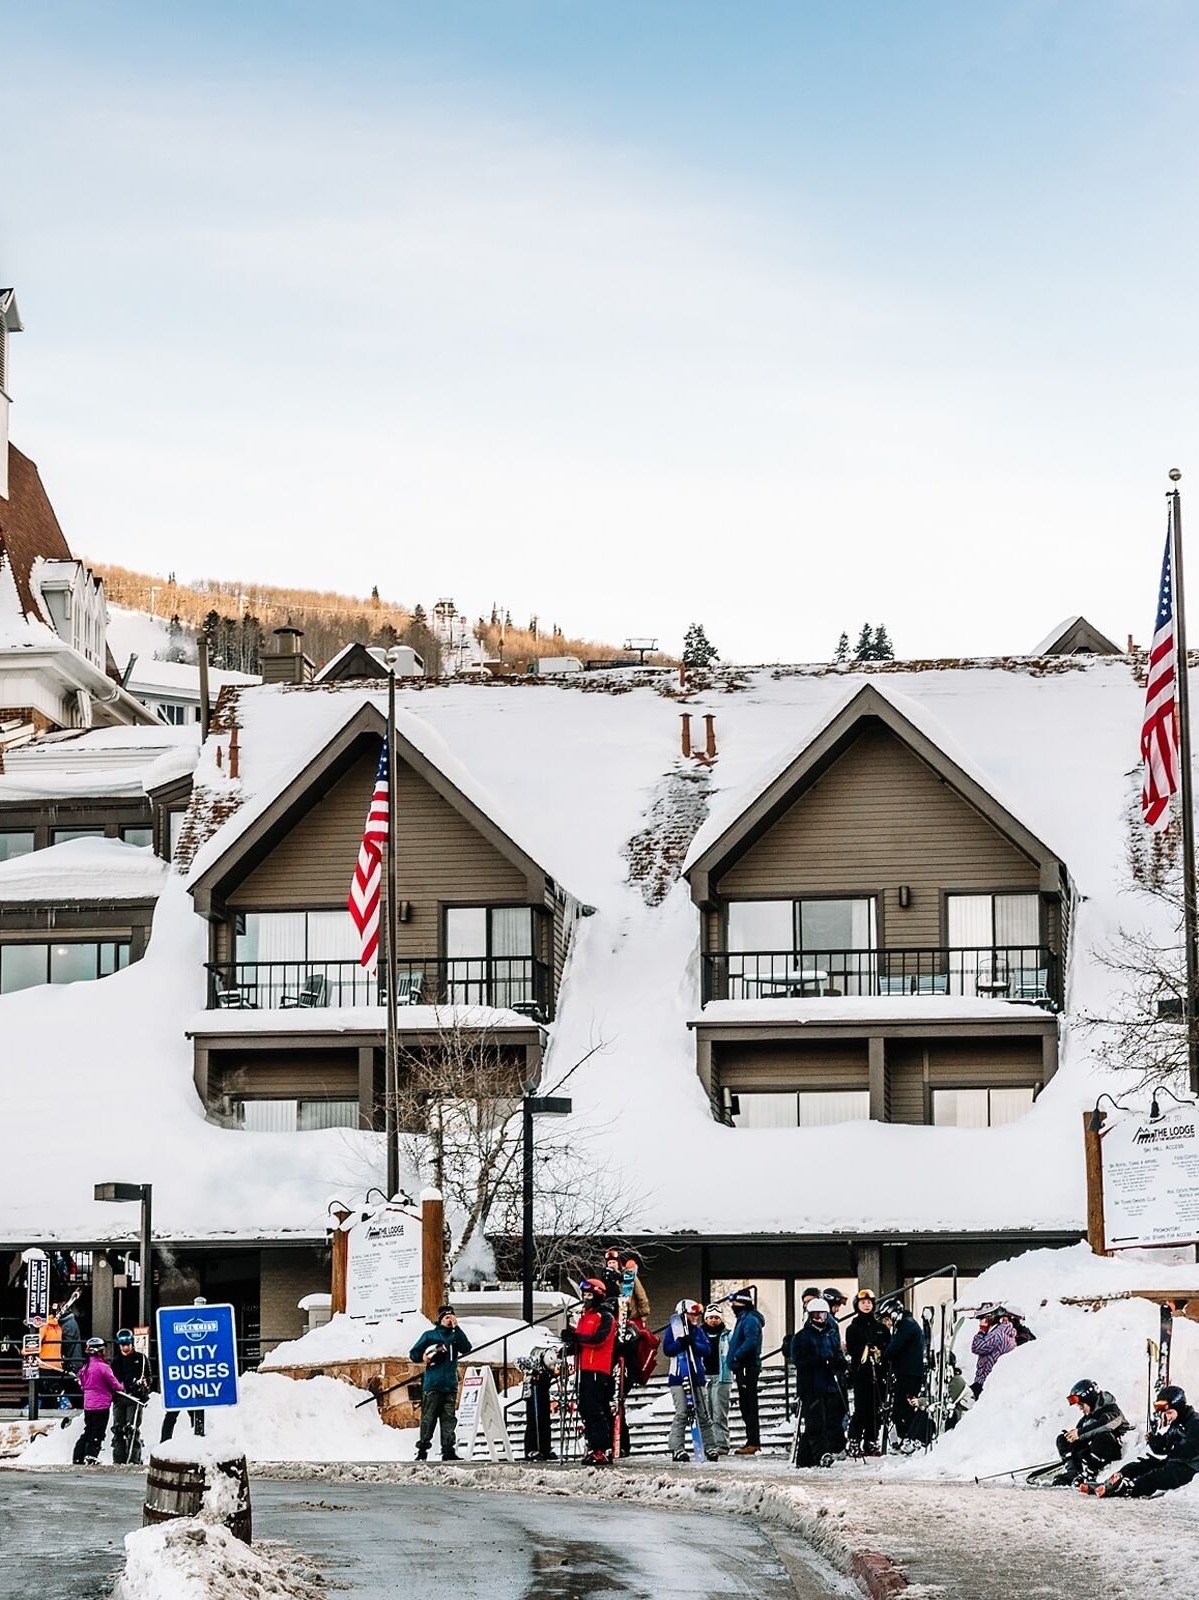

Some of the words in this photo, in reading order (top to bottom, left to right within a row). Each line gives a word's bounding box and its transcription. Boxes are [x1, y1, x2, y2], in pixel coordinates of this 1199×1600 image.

[1154, 1127, 1168, 1137] THE
[1169, 1124, 1195, 1136] LODGE
[388, 1225, 404, 1234] LODGE
[177, 1345, 218, 1361] CITY
[168, 1362, 230, 1381] BUSES
[177, 1382, 222, 1399] ONLY
